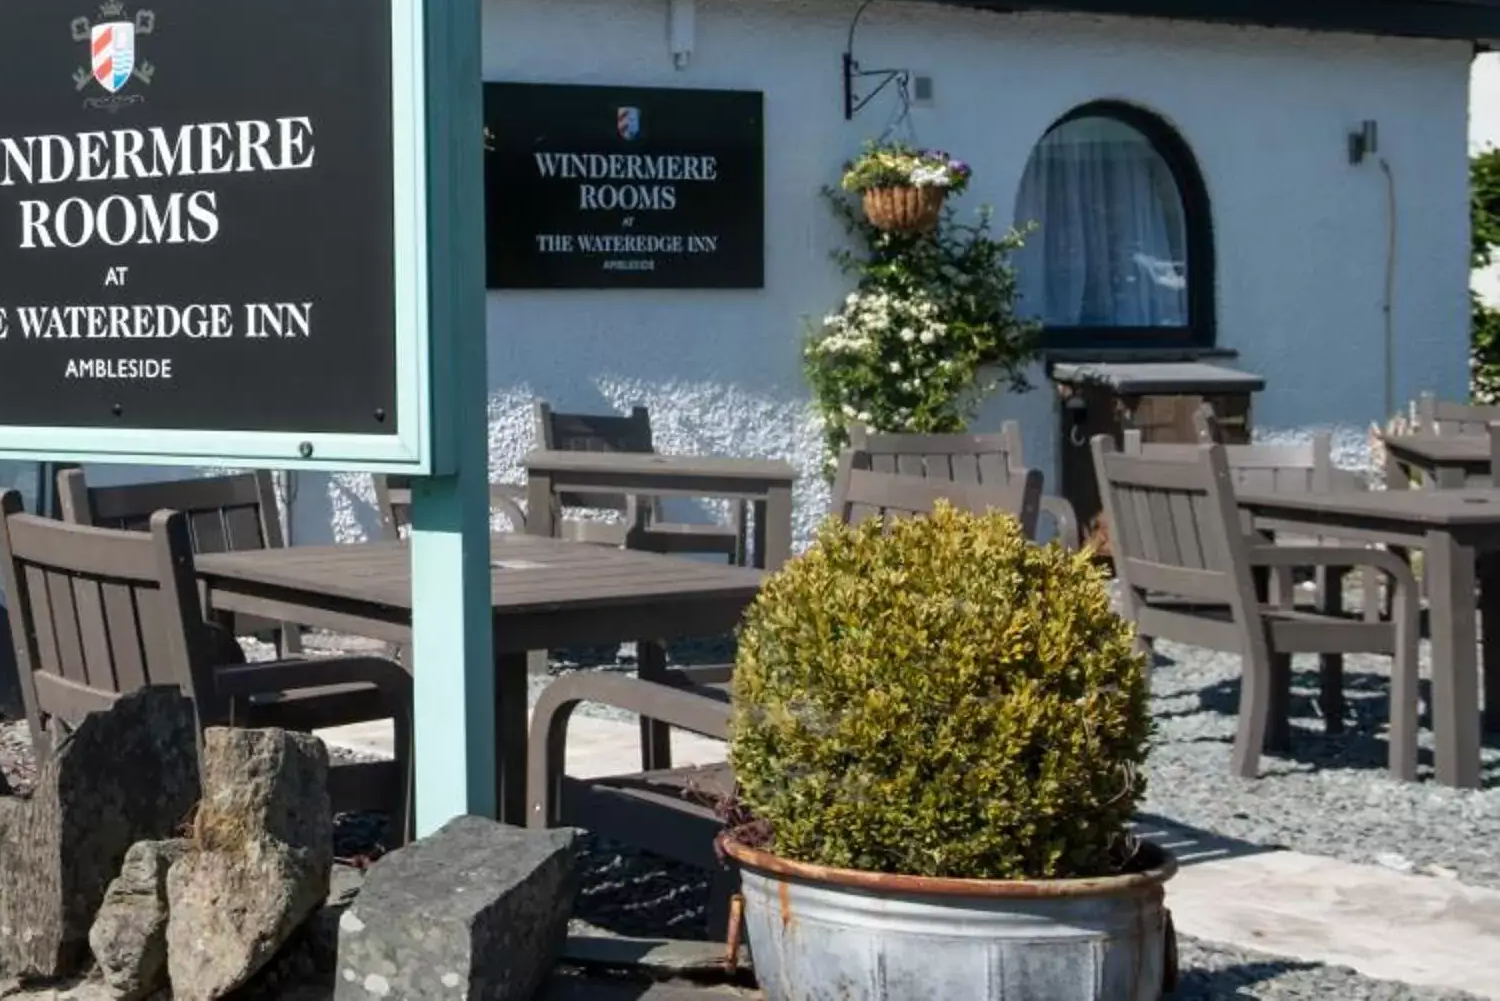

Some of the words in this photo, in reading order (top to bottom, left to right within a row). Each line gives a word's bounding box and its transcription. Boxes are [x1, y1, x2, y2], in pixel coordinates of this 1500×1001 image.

[534, 152, 718, 181] WINDERMERE
[579, 184, 677, 211] ROOMS
[18, 190, 220, 249] ROOMS
[536, 235, 574, 253] THE
[576, 234, 683, 253] WATEREDGE
[687, 235, 719, 253] INN
[104, 266, 129, 287] AT
[16, 303, 233, 340] WATEREDGE
[244, 302, 314, 338] INN
[64, 358, 173, 380] AMBLESIDE
